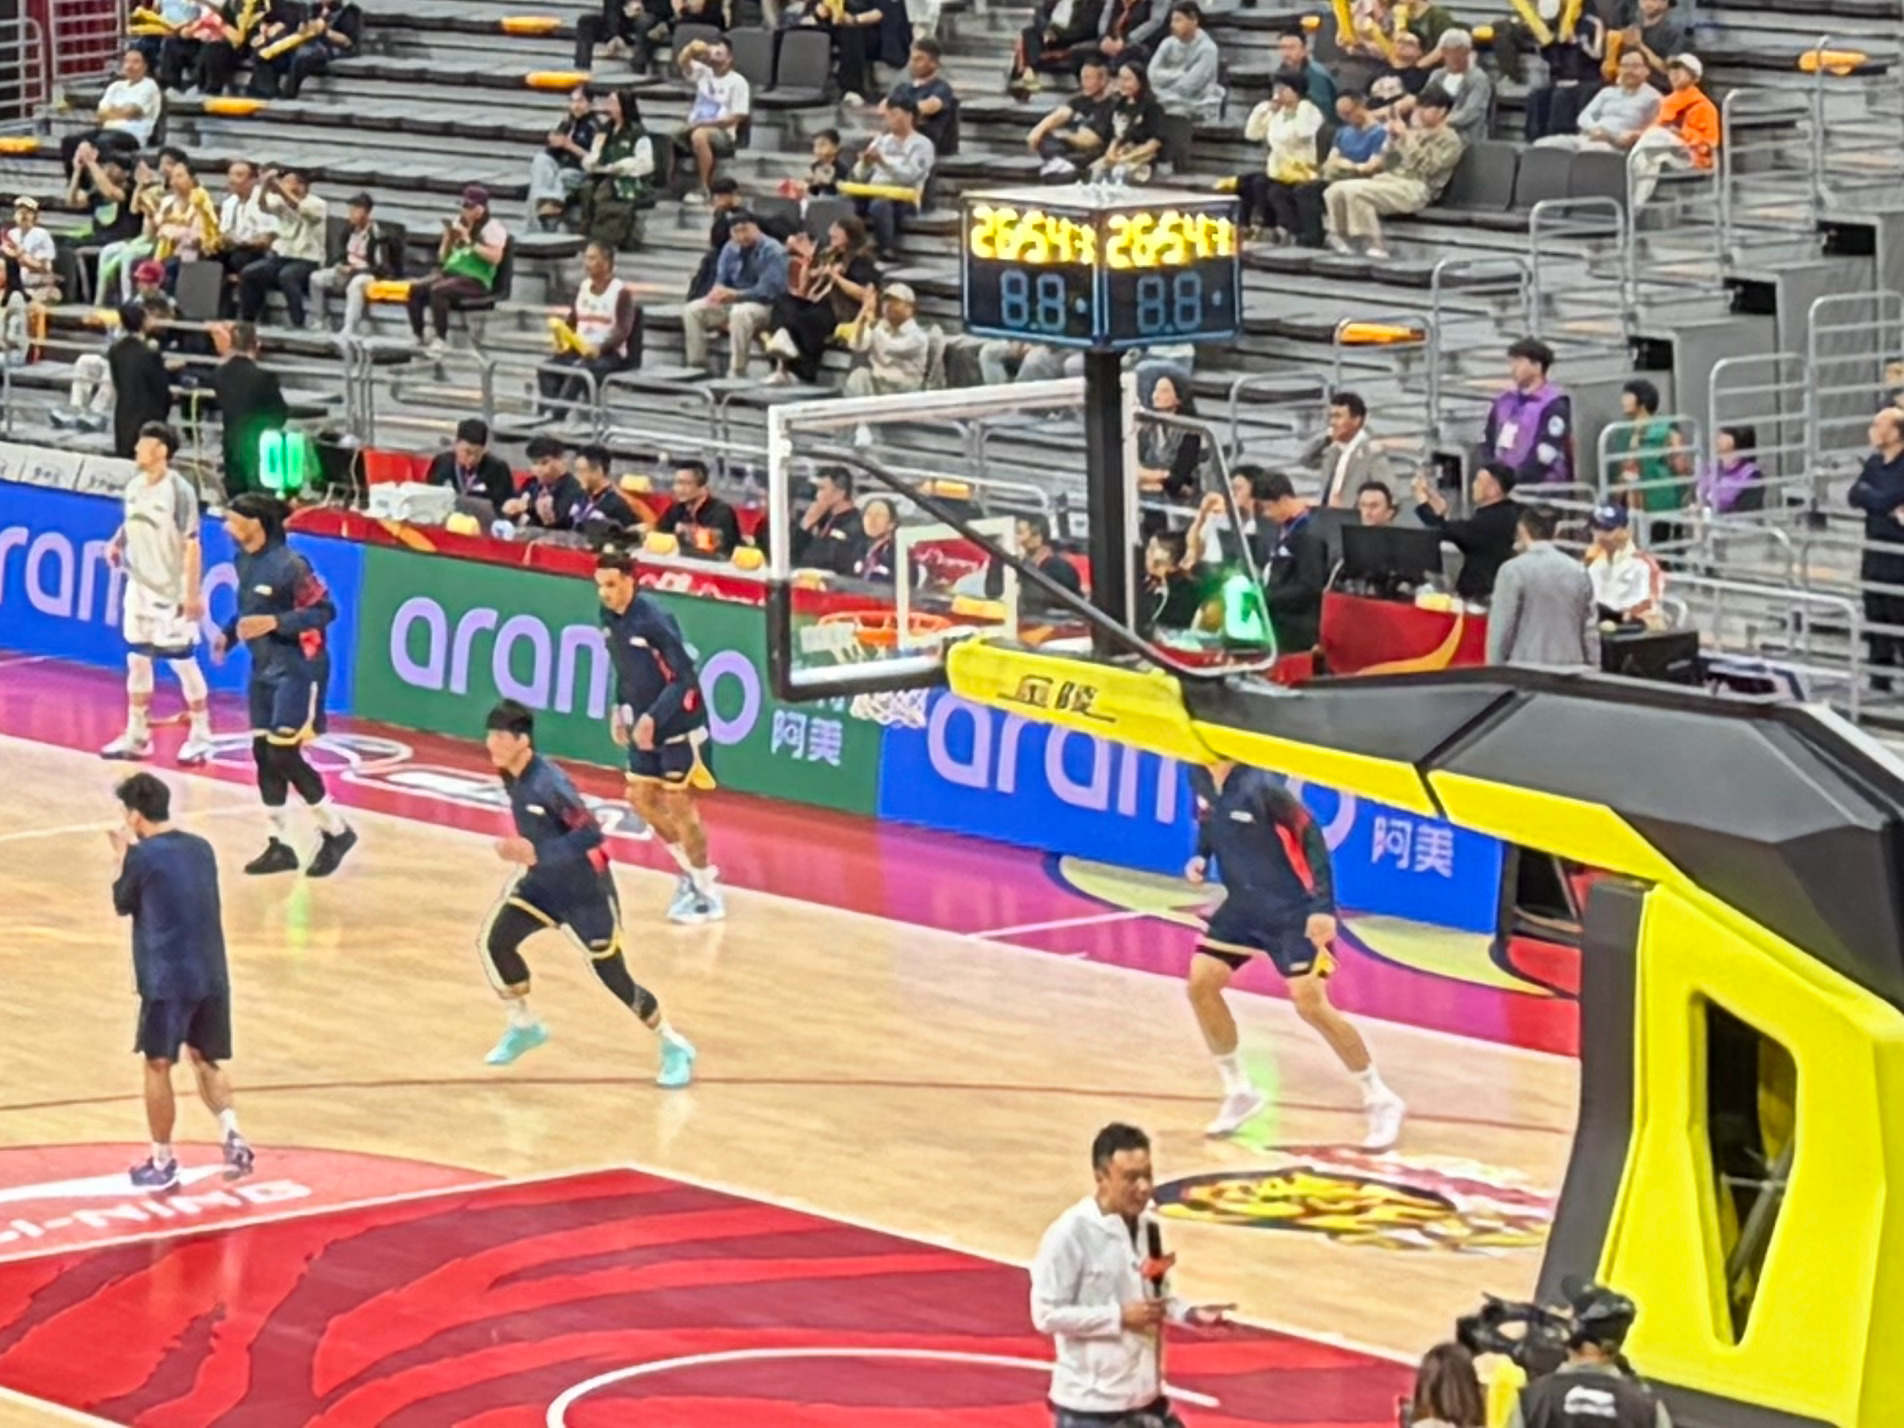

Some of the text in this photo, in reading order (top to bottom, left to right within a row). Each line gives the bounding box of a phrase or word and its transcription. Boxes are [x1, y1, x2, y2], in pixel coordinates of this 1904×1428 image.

[996, 673, 1117, 723] 金陵
[770, 708, 844, 767] 阿美
[1371, 815, 1455, 879] 阿美
